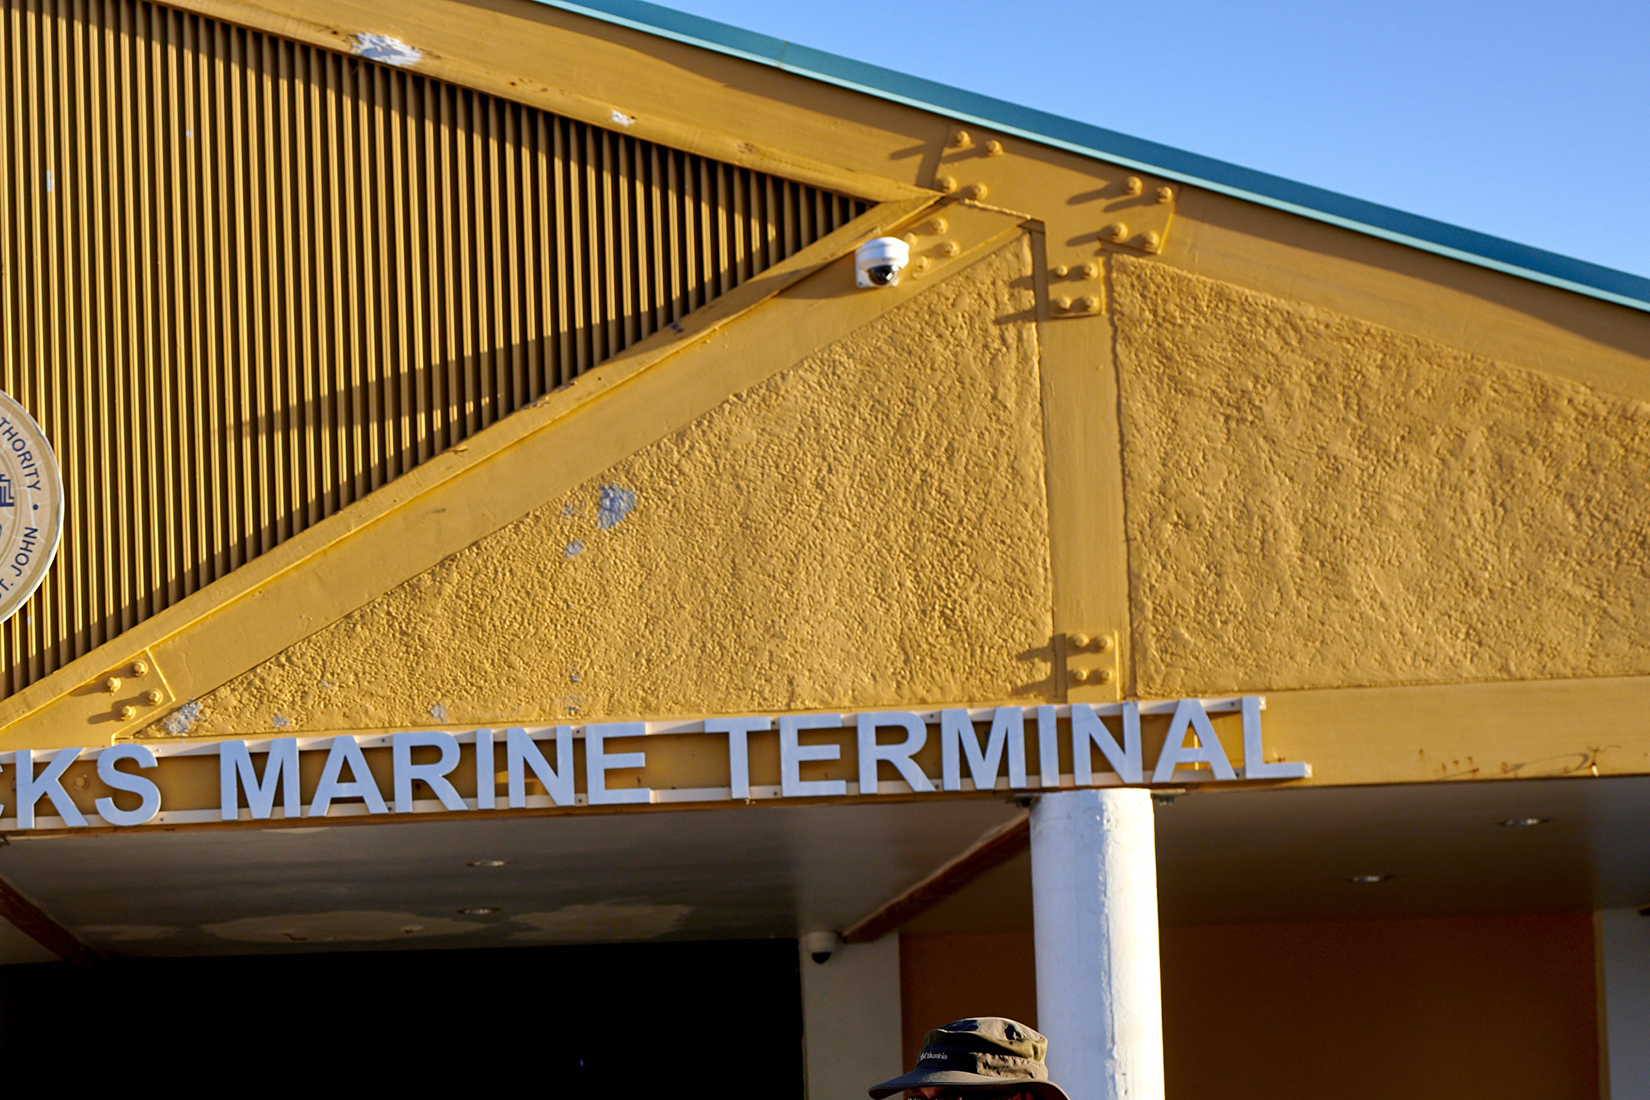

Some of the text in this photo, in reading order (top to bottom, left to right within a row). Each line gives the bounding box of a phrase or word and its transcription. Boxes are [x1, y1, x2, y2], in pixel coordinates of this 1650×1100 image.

[10, 526, 40, 578] JOHN
[219, 721, 651, 821] MARINE
[704, 696, 1312, 799] TERMINAL
